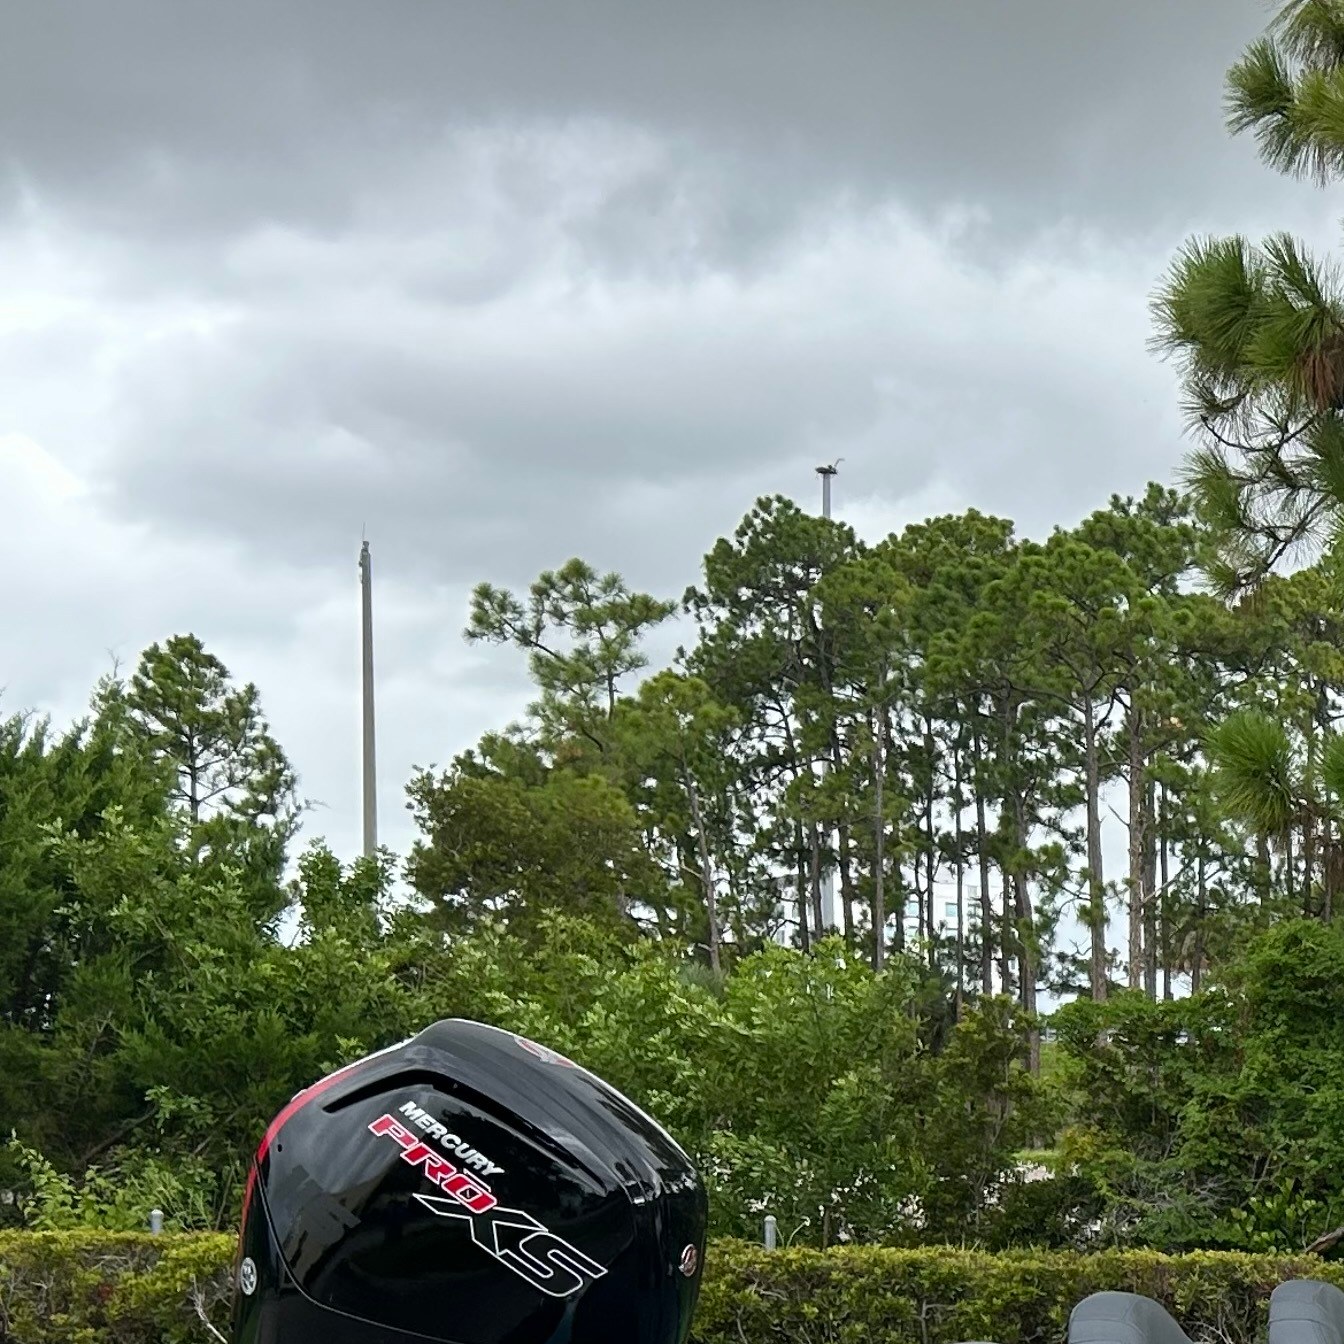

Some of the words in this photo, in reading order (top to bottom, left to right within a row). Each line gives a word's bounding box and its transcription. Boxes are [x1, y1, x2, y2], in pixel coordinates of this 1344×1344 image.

[368, 1114, 498, 1213] PRO
[400, 1101, 505, 1176] MERCURY
[412, 1193, 608, 1297] XS
